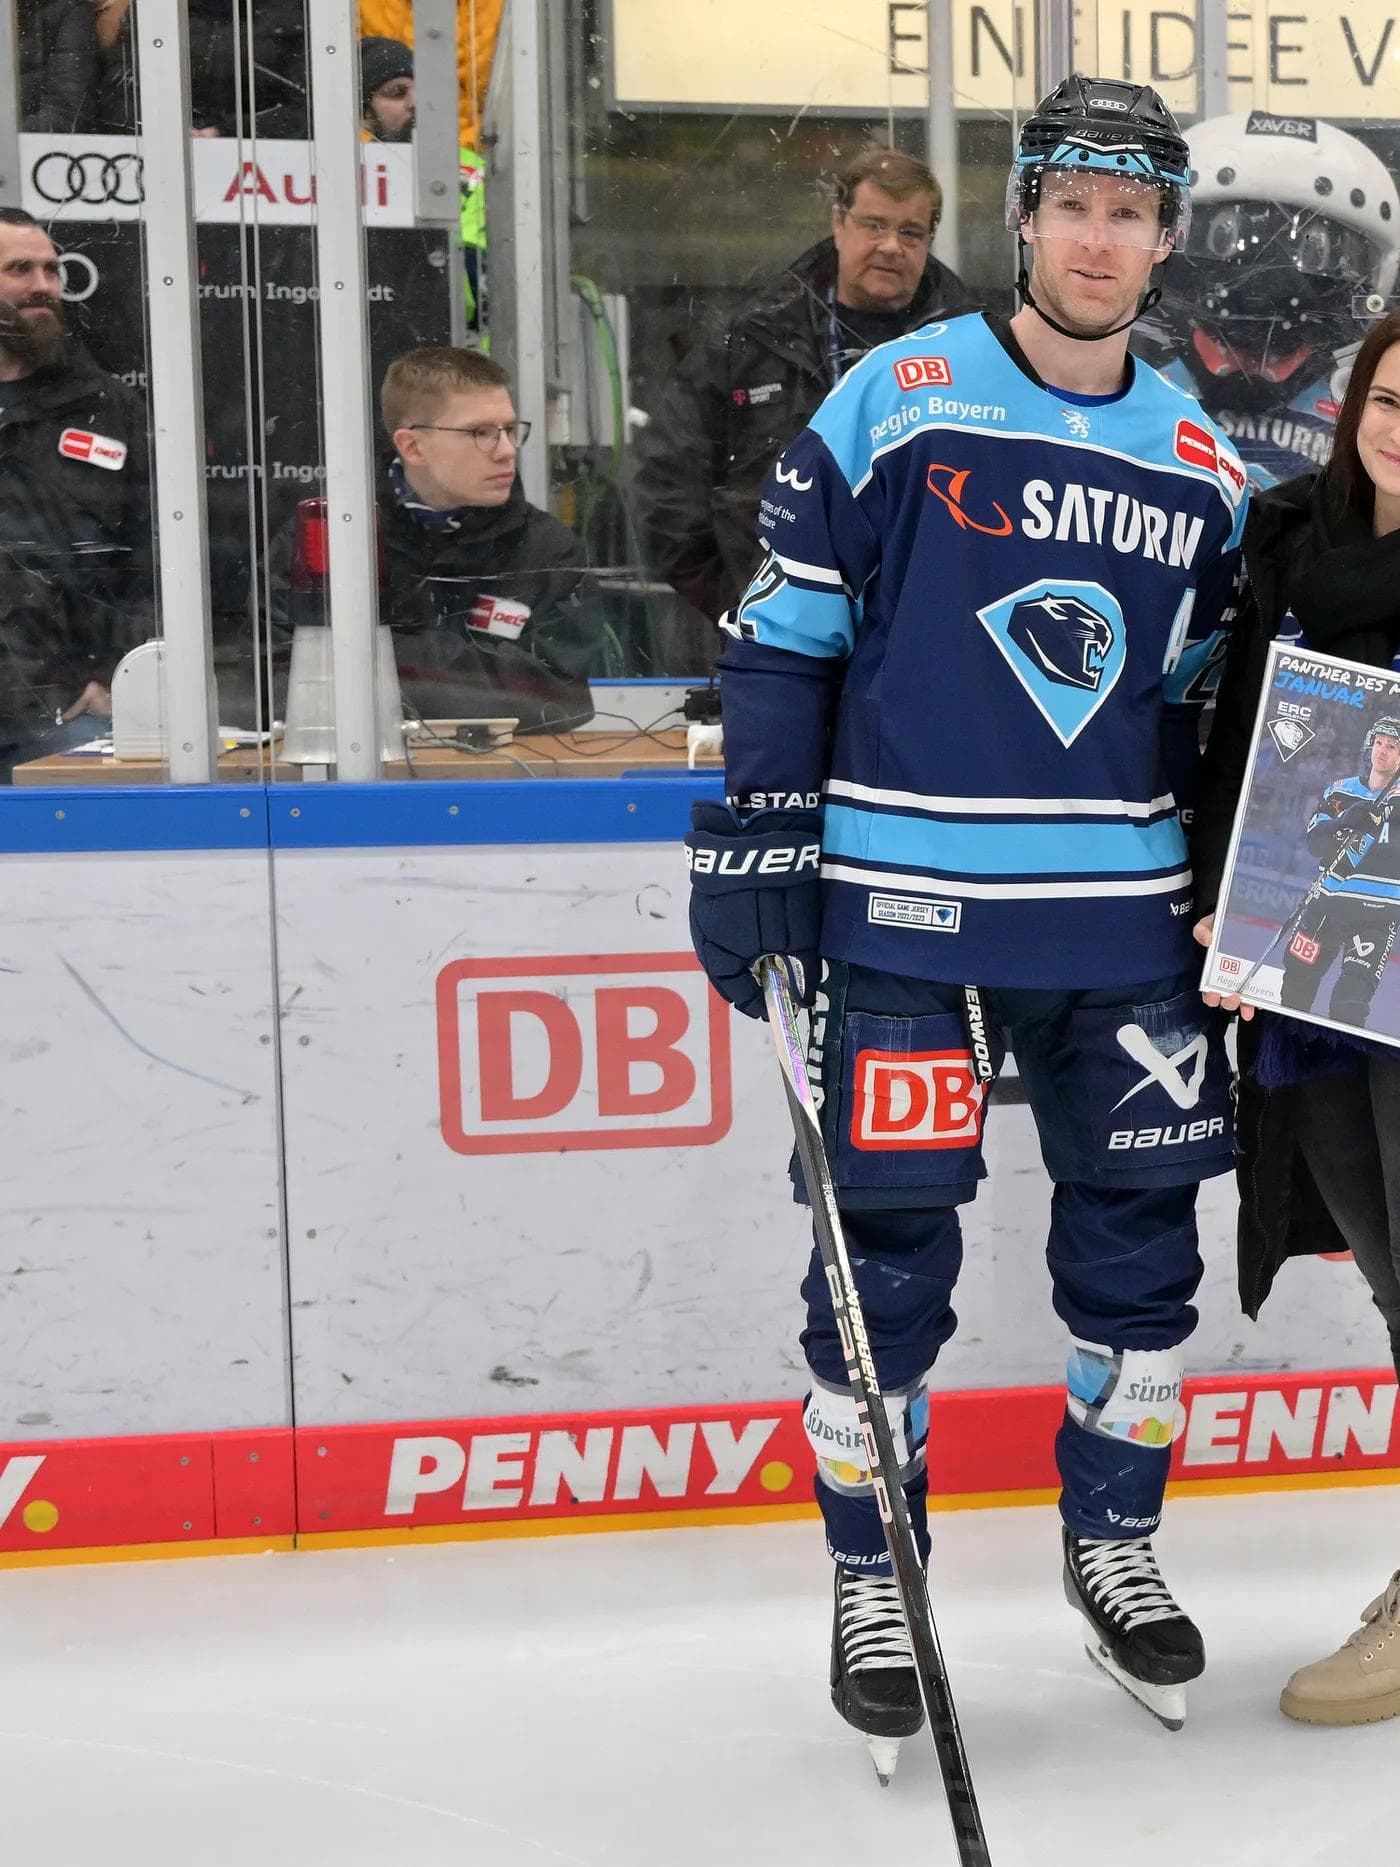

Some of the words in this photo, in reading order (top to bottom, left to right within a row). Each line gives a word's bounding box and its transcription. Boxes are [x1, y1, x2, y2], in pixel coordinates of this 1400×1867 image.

[1249, 118, 1314, 137] XAVER
[222, 161, 389, 207] Aui
[901, 360, 944, 385] DB
[928, 396, 1006, 422] Bayern
[1021, 478, 1205, 570] SATURN
[1162, 587, 1197, 675] A
[1273, 670, 1366, 710] JANUAR
[1278, 655, 1352, 685] PANTHER
[1355, 674, 1388, 693] DES
[1277, 700, 1313, 718] ERC
[476, 986, 697, 1122] DB
[964, 984, 995, 1083] ERWOO
[871, 1066, 978, 1133] DB
